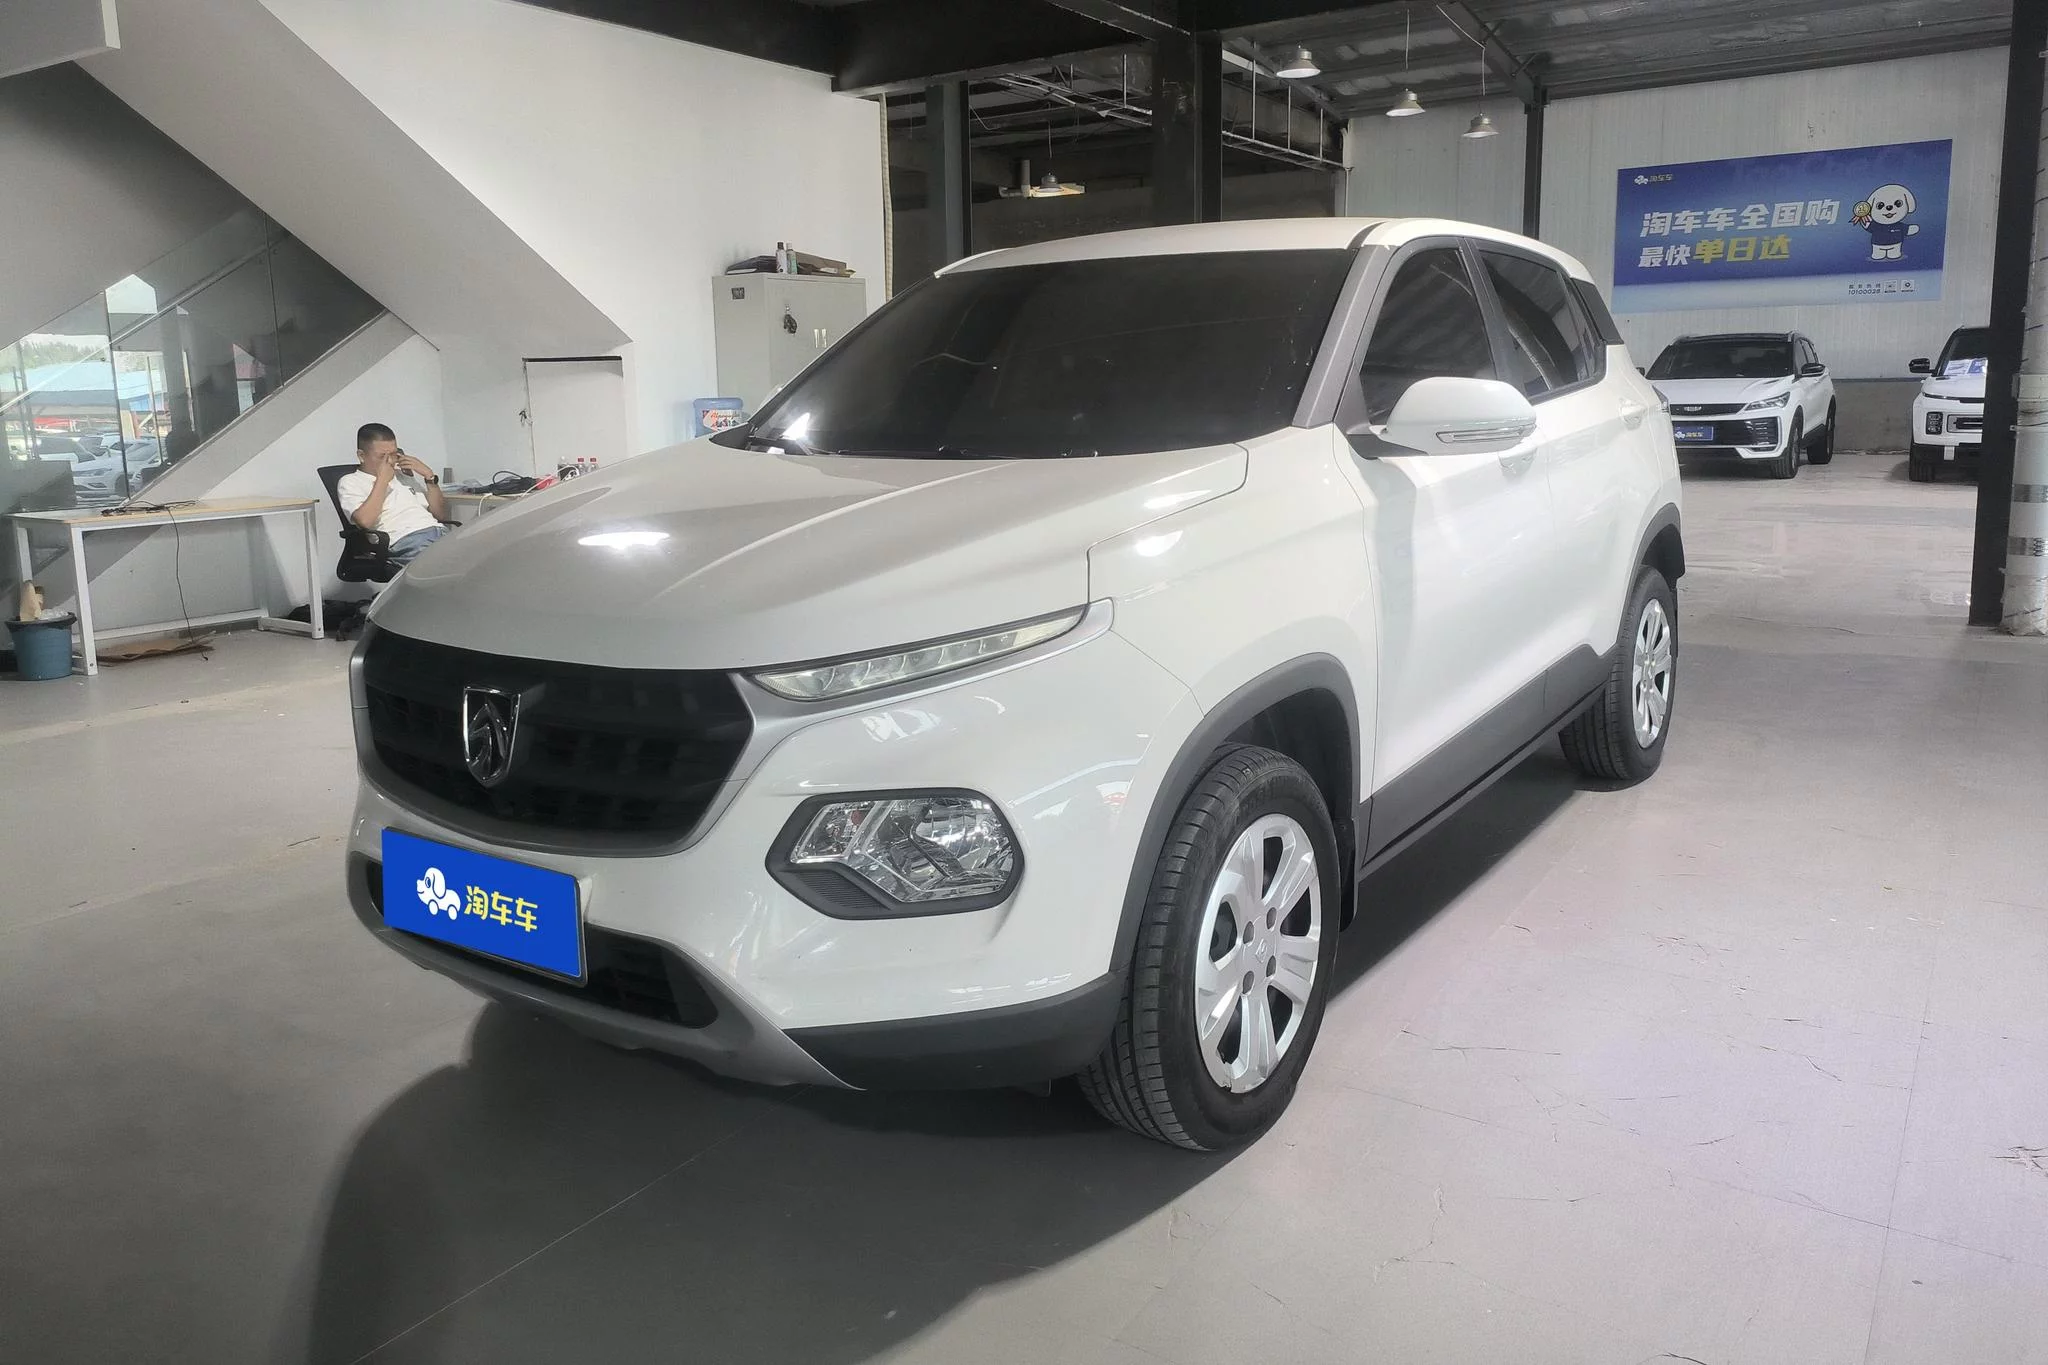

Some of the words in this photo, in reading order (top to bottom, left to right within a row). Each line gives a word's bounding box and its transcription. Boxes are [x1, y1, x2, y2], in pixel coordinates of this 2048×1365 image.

[1640, 199, 1840, 237] 淘车车全国购
[1638, 234, 1792, 268] 最快单日达
